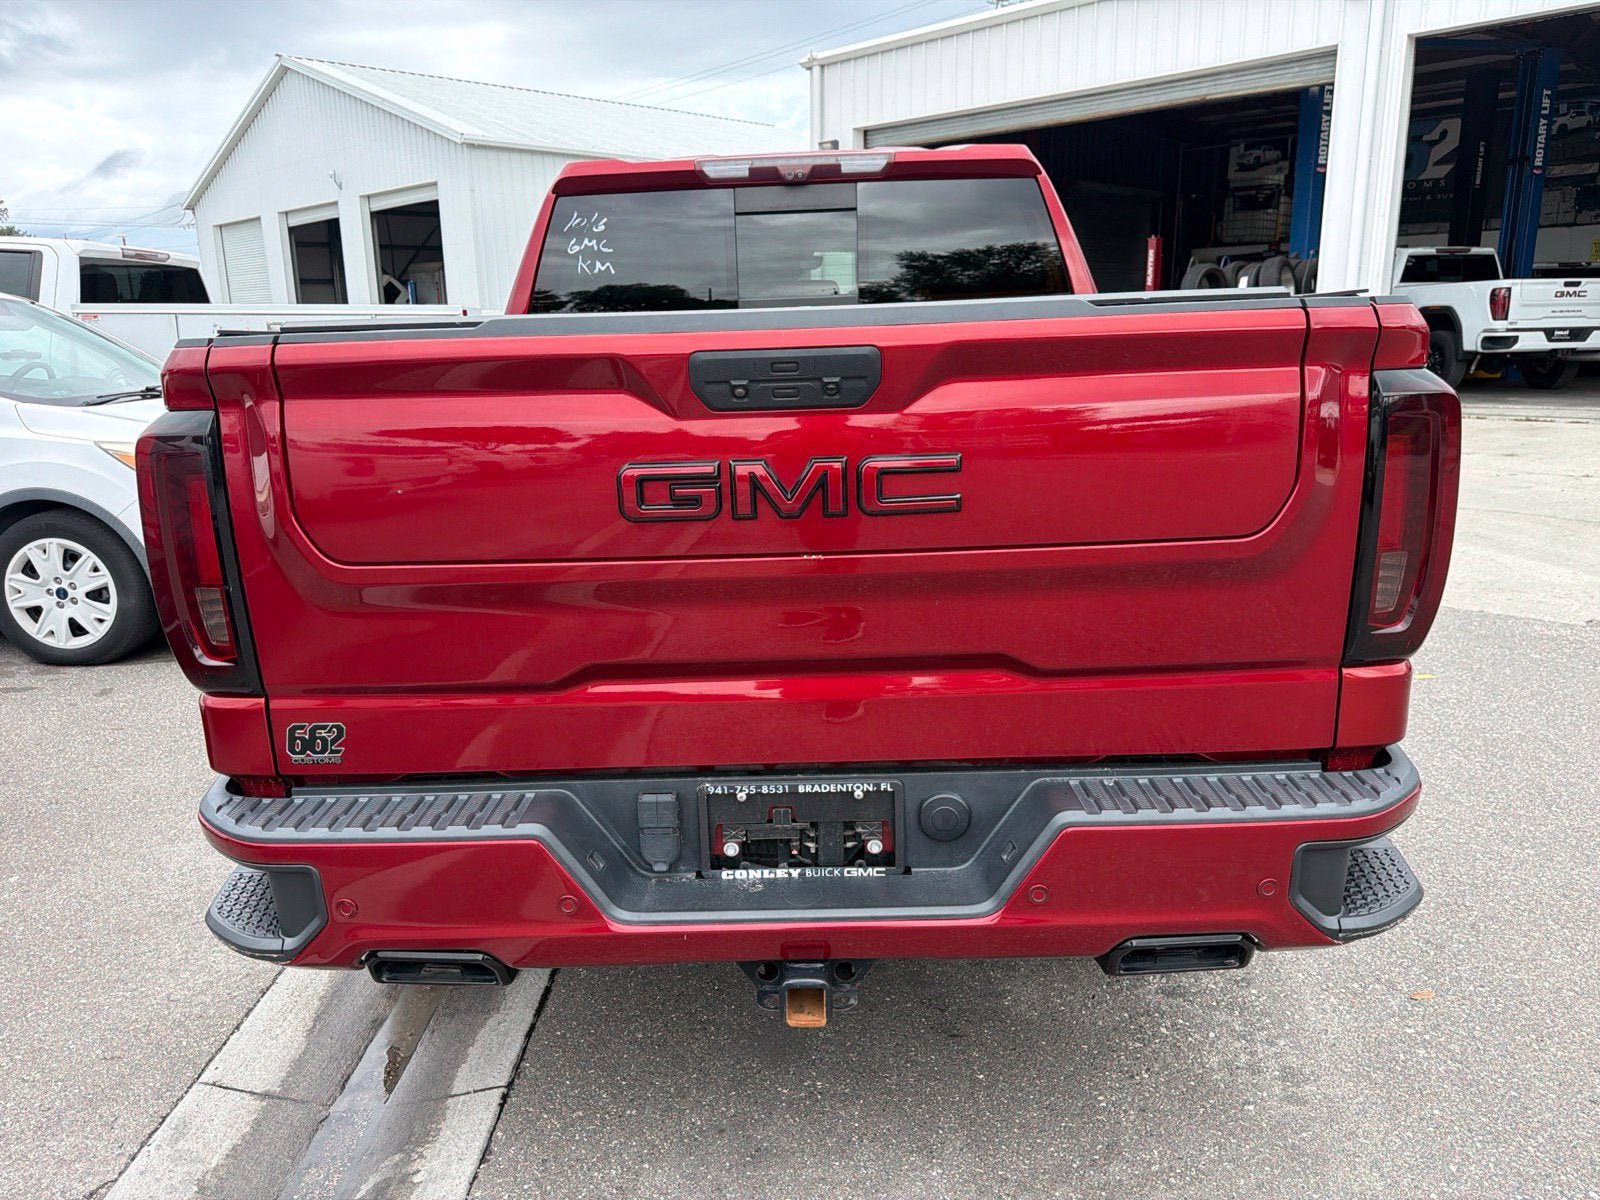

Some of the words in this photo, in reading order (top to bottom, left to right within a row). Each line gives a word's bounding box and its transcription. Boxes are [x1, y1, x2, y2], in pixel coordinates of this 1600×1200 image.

[1323, 85, 1334, 111] LIFT
[1541, 89, 1552, 114] LIFT
[1317, 113, 1331, 164] ROTARY
[1535, 118, 1548, 166] ROTARY
[567, 237, 613, 254] GMC
[577, 255, 616, 276] KM
[1554, 290, 1588, 298] GMC
[617, 452, 962, 523] GMC
[286, 722, 346, 757] 662
[291, 757, 342, 765] CUSTOMS
[708, 785, 789, 795] 941-755-8531
[881, 782, 894, 792] FL
[721, 868, 801, 880] CONLEY
[805, 867, 841, 877] BUICK
[844, 867, 886, 877] GMC
